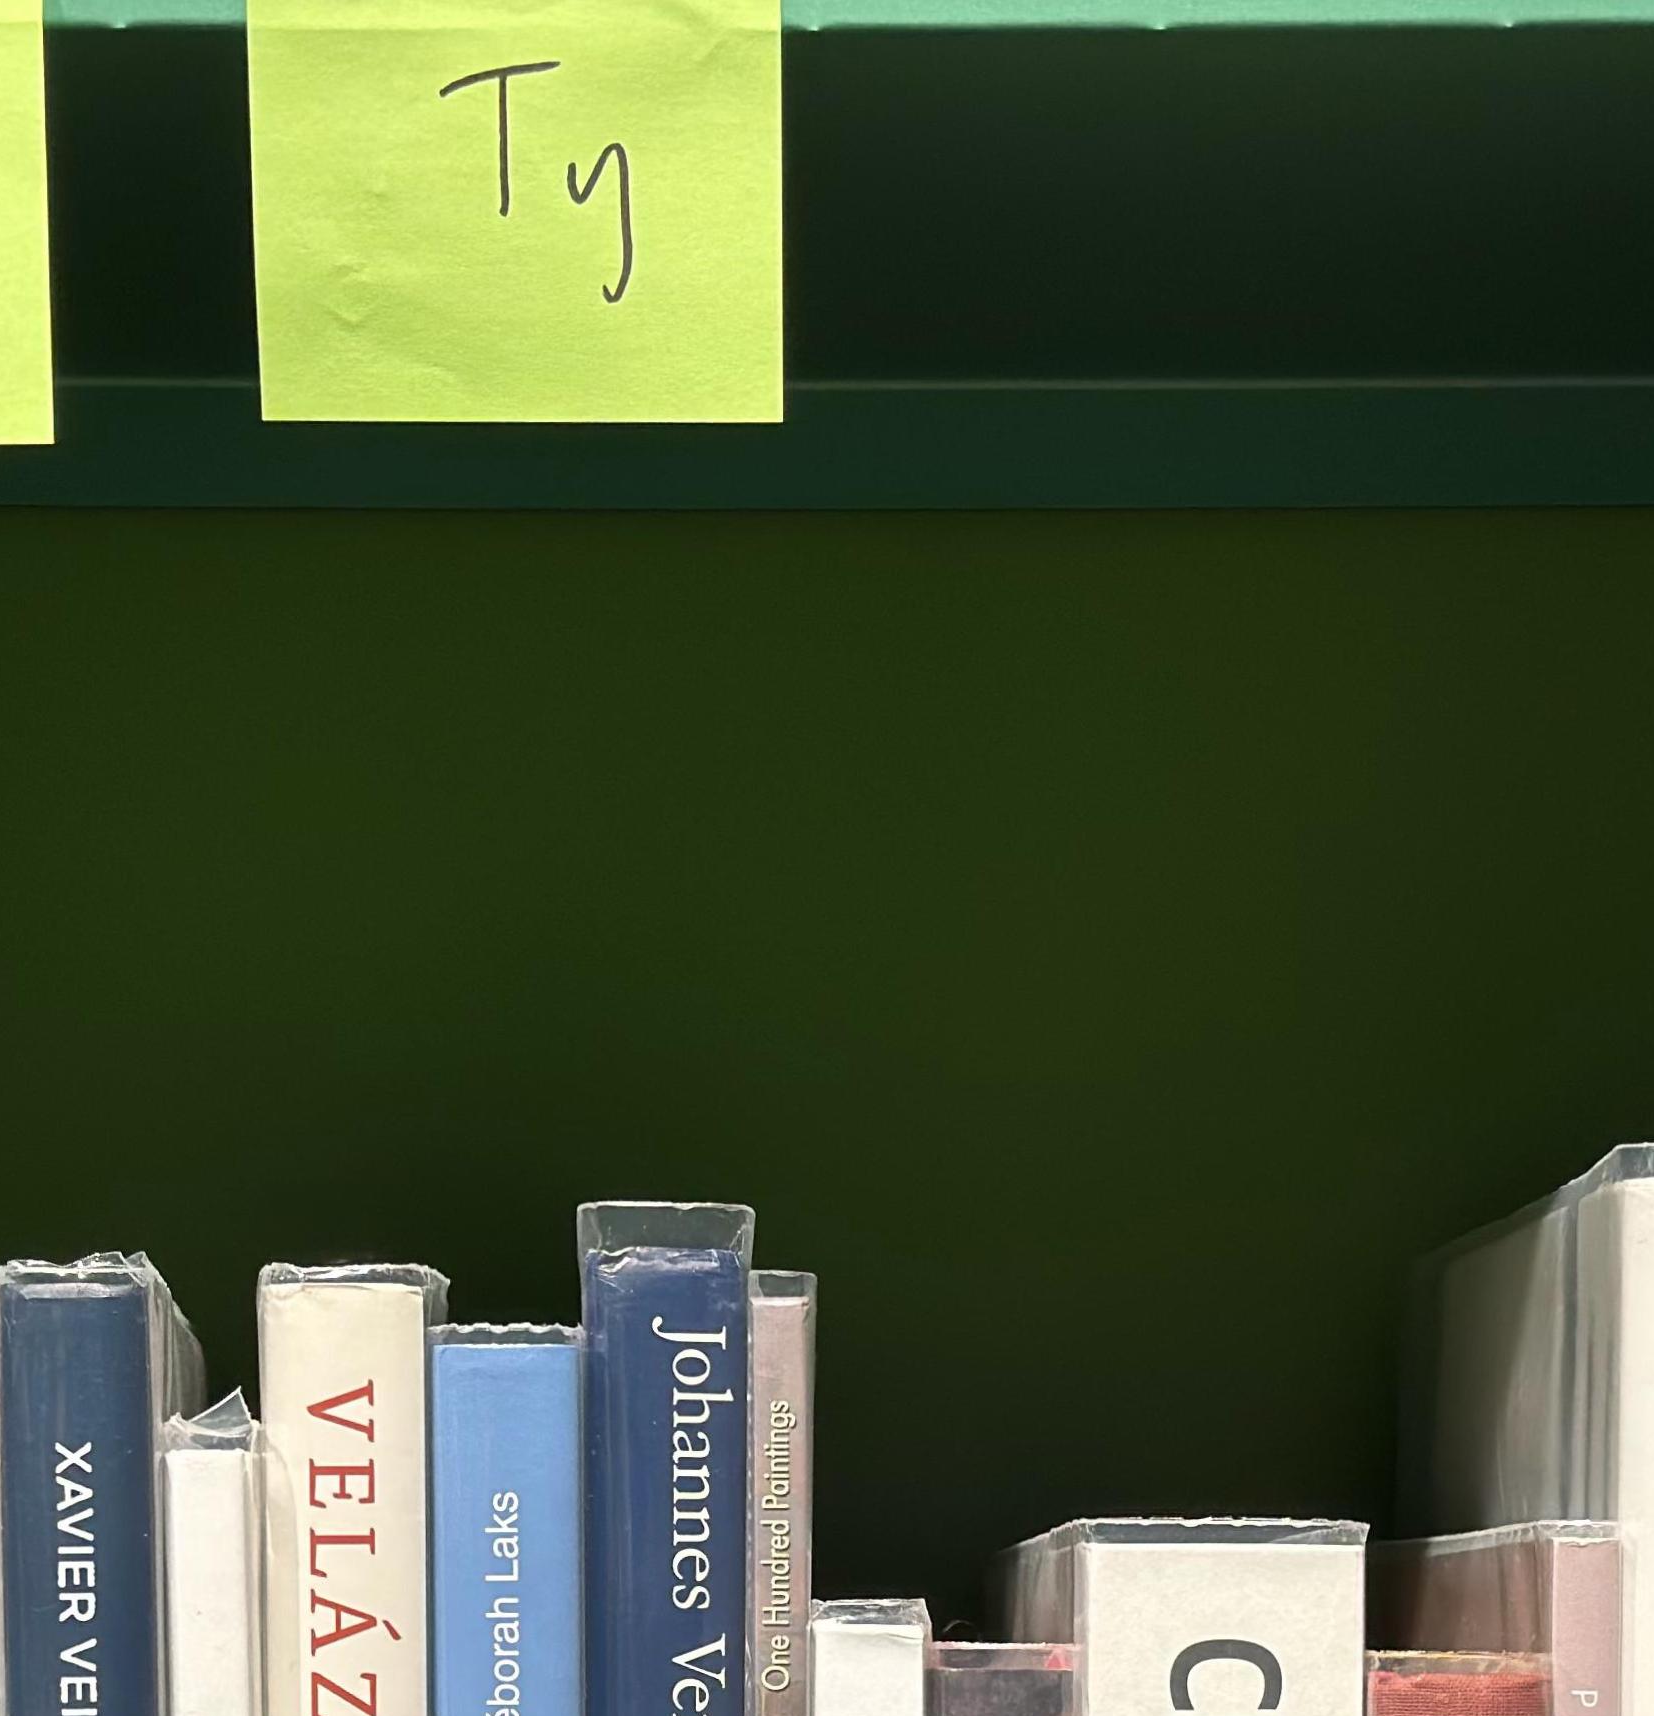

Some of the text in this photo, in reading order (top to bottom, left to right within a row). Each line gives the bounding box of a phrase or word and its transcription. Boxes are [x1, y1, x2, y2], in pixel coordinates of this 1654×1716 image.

[439, 59, 634, 303] Ty
[55, 1442, 96, 1622] XAVIER
[487, 1491, 520, 1582] Laks
[652, 1315, 734, 1610] Johannes
[762, 1399, 797, 1692] One Hundred Paintings
